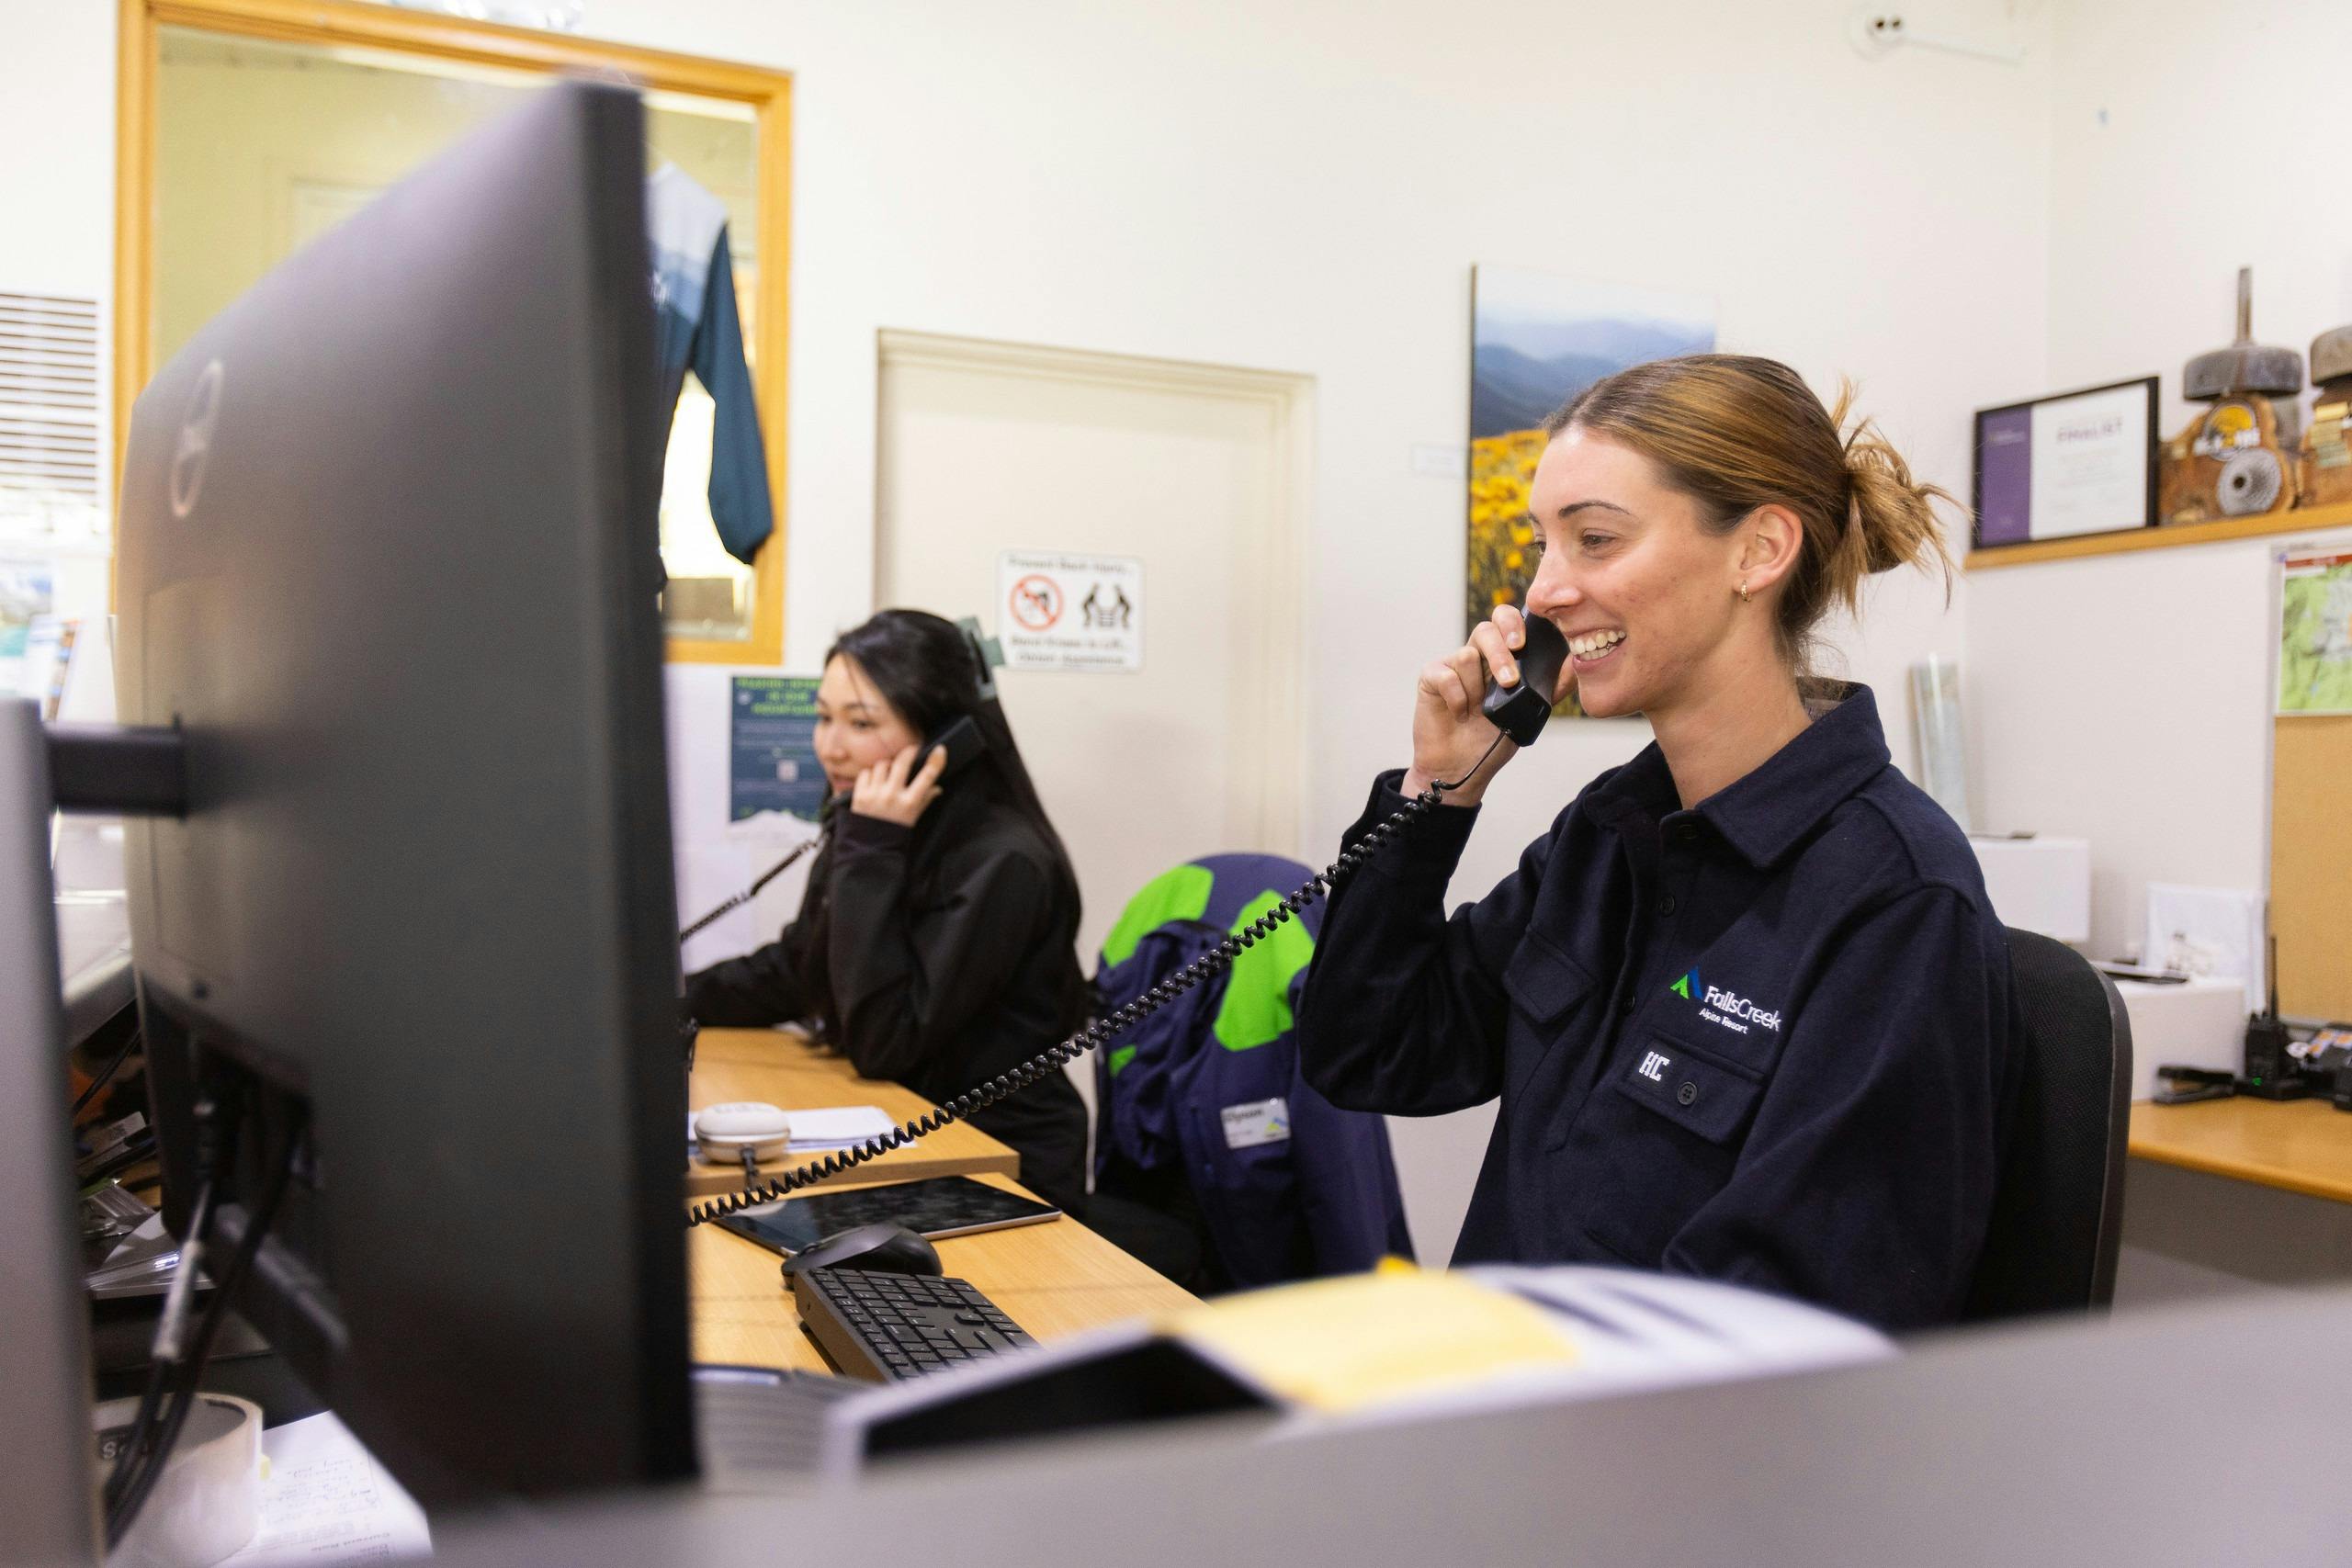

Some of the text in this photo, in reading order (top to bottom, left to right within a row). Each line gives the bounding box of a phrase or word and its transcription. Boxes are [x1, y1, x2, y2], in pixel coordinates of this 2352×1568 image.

[1698, 1008, 1749, 1035] Alpine Resort
[1703, 985, 1783, 1032] FallsCreek
[1638, 1051, 1670, 1082] HC
